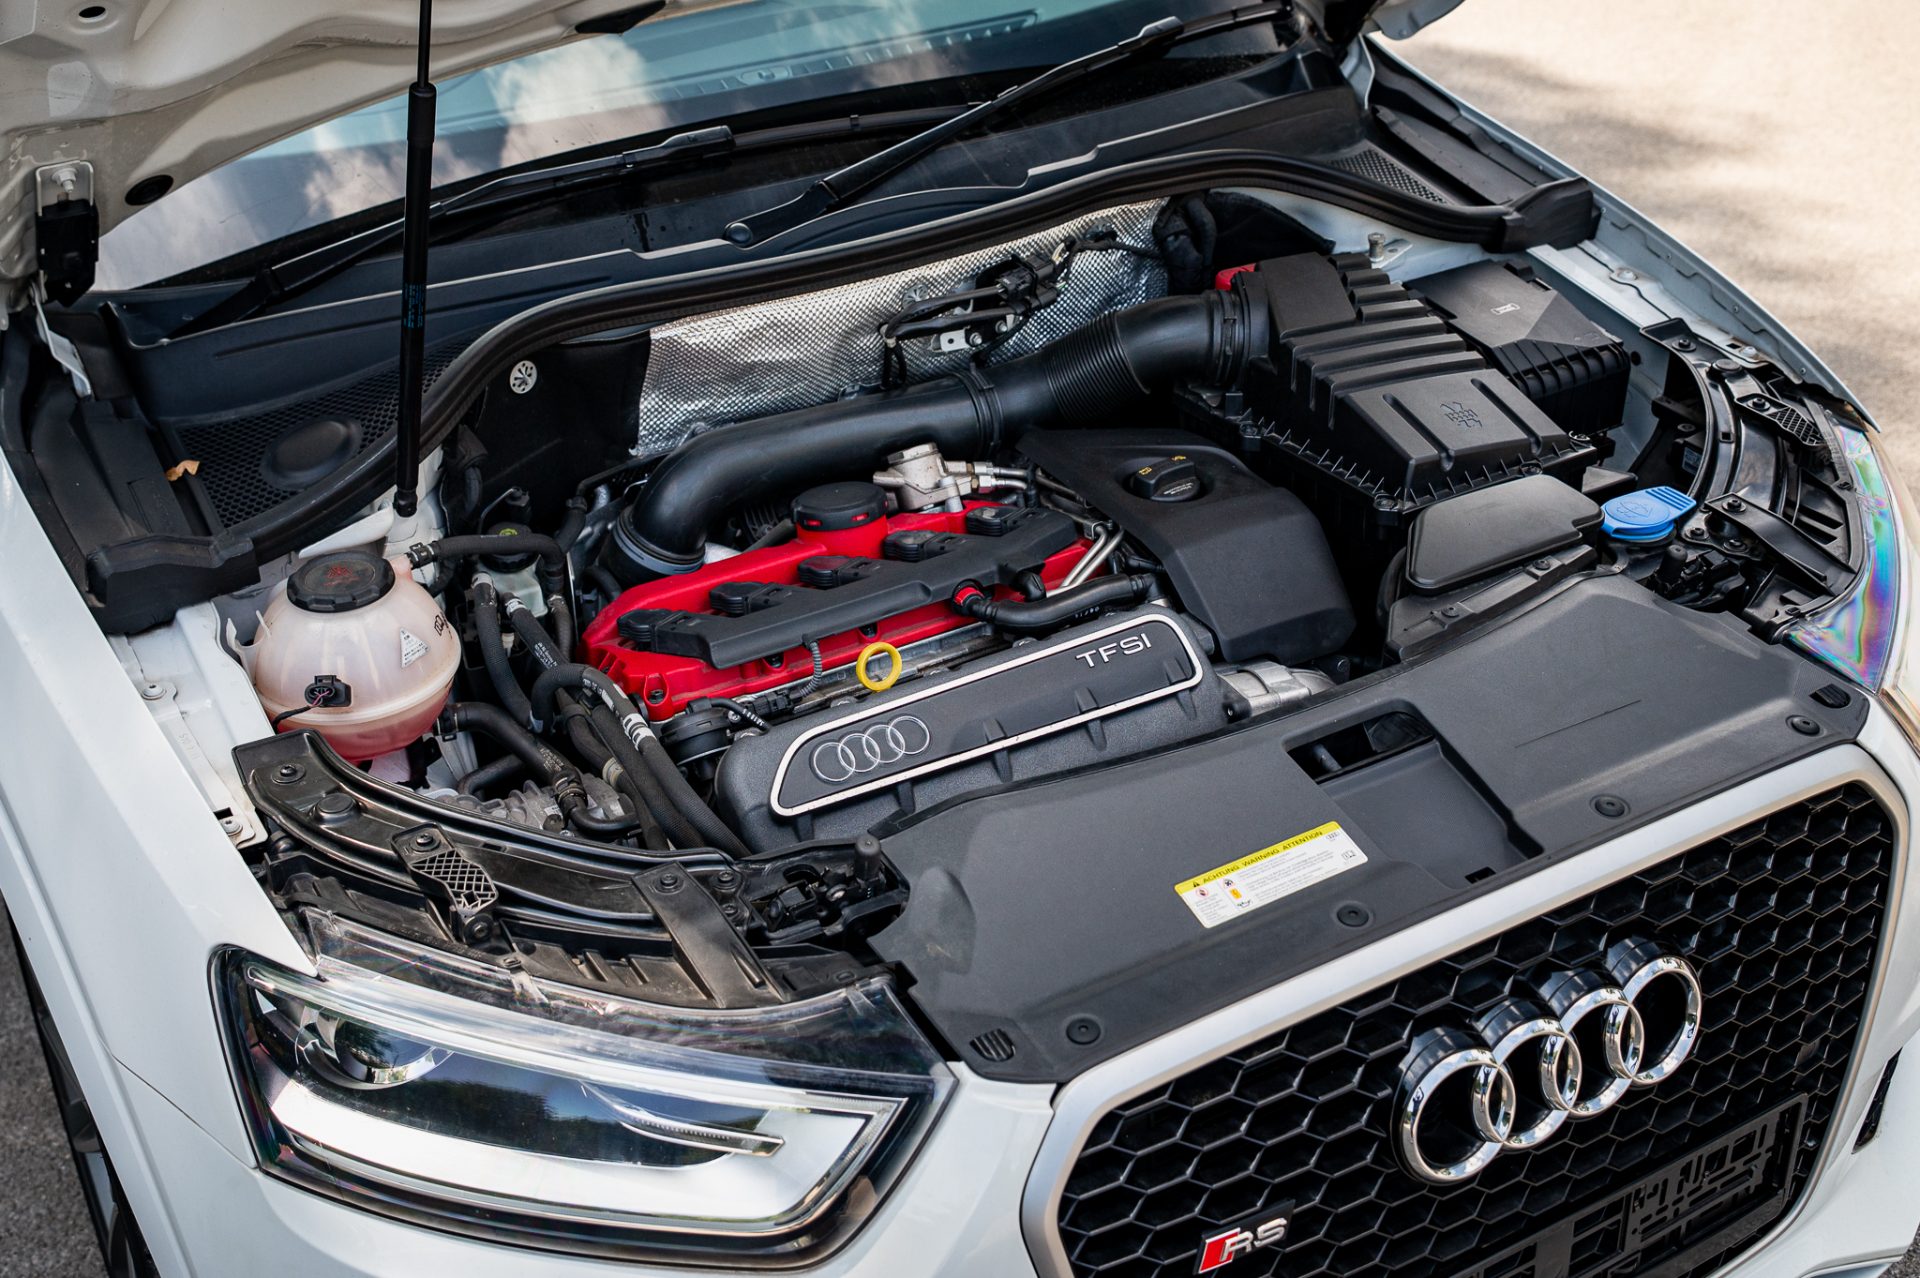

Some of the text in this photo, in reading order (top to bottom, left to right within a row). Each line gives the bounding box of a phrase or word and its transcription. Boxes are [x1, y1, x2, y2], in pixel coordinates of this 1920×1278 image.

[1076, 633, 1152, 668] TFSI
[1202, 830, 1323, 883] ACHTUNG WARNING ATTENTION
[1219, 1217, 1288, 1263] RS
